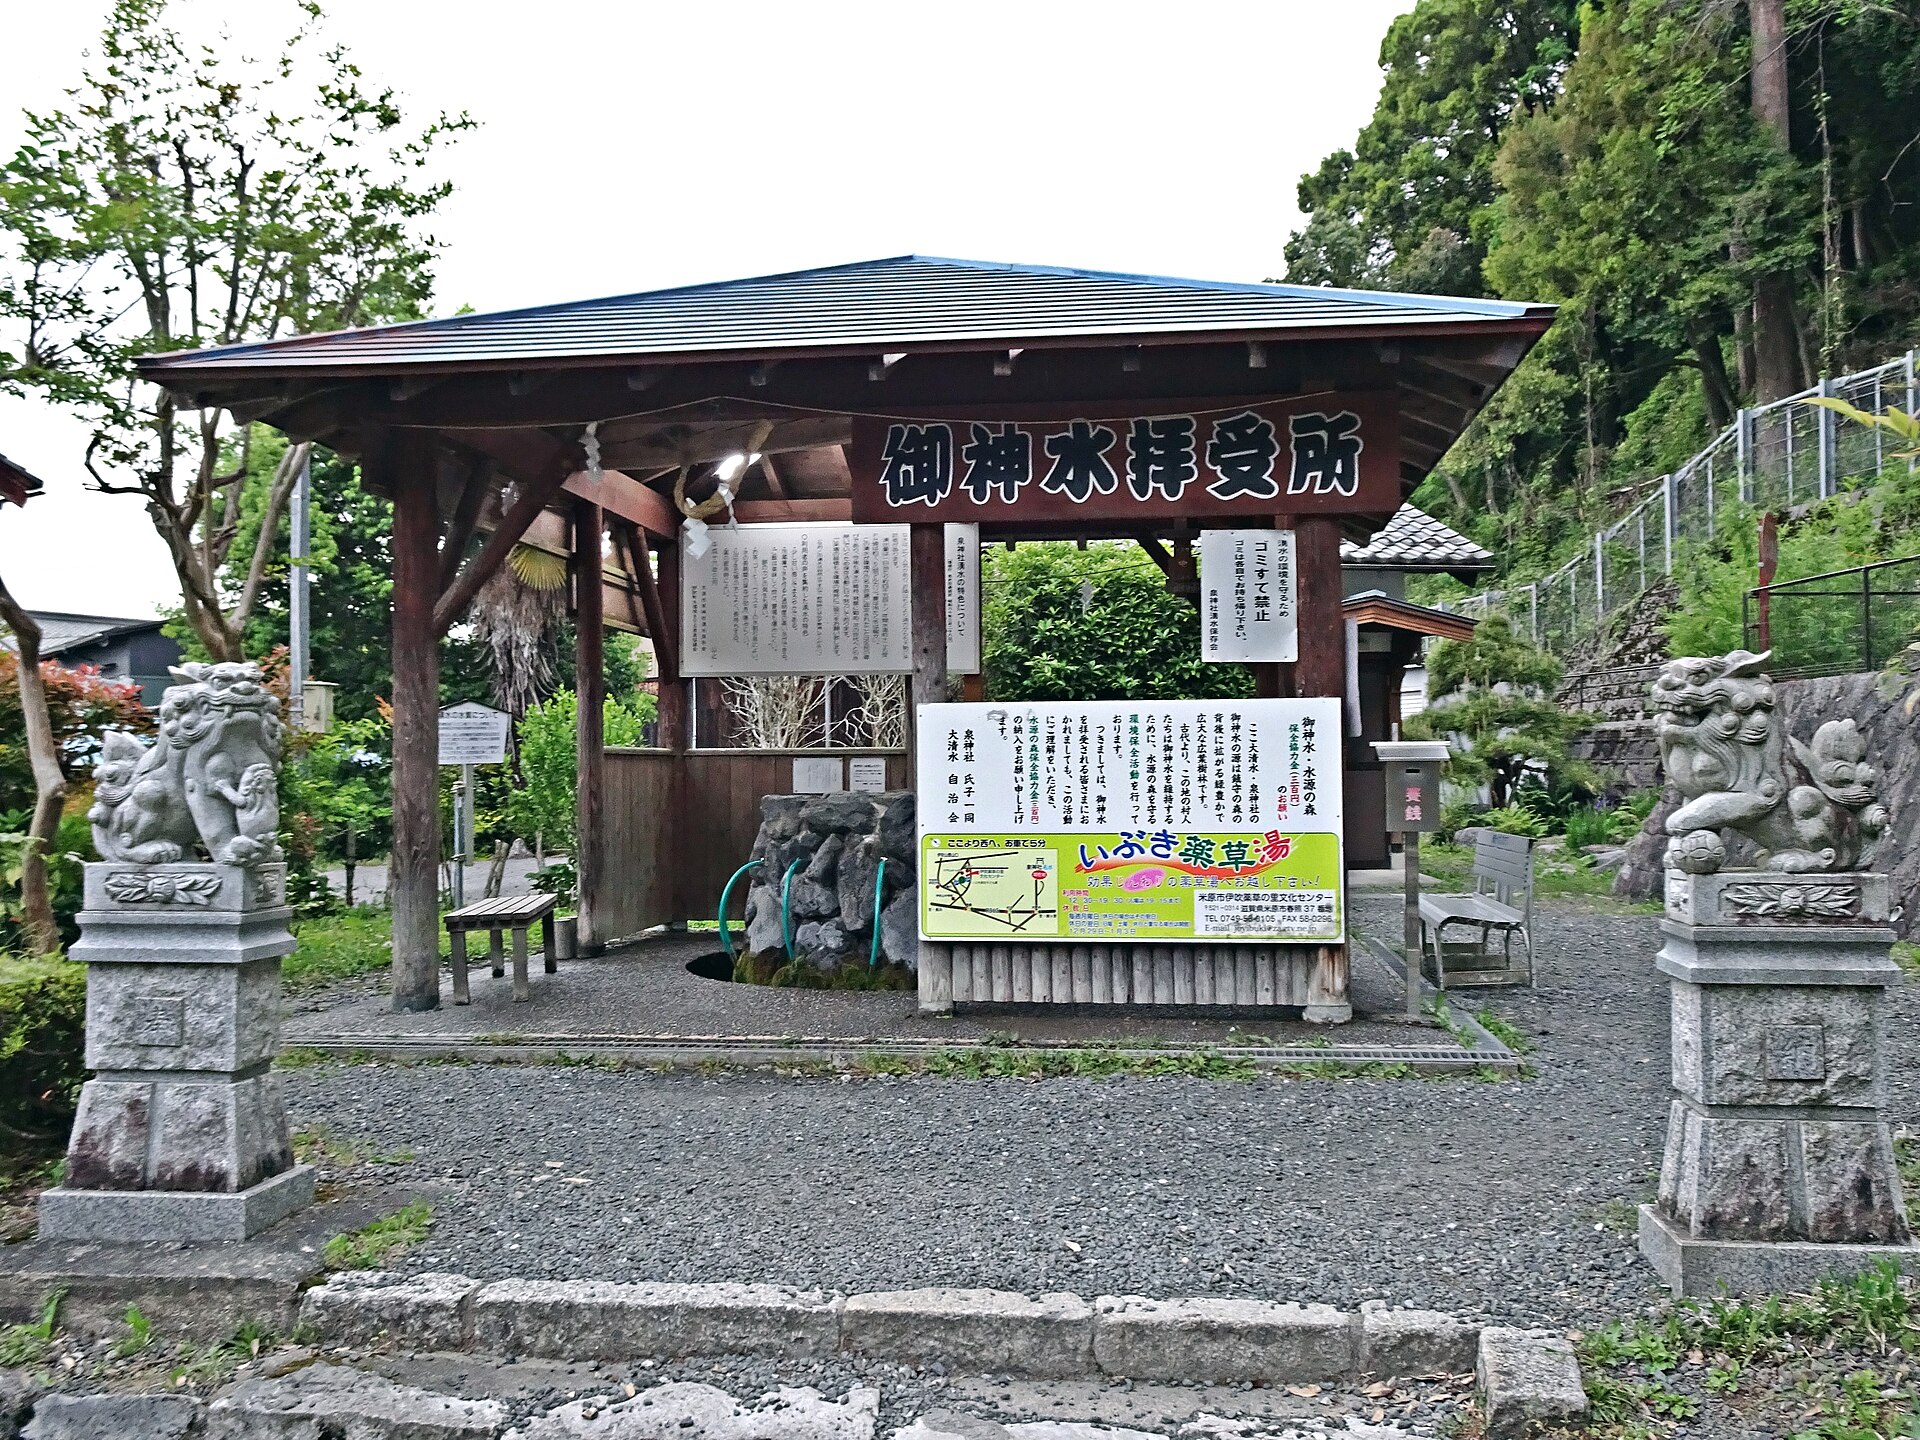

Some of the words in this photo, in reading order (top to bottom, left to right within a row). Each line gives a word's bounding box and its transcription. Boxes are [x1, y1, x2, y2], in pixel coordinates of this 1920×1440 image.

[878, 410, 1364, 507] 御神水拝受所
[1254, 540, 1271, 622] ゴミすて禁止
[1277, 539, 1289, 618] 湧水の環境を守るため
[1209, 589, 1218, 651] 泉神社湧水保存会
[1302, 716, 1318, 815] 御神水・水源の森
[964, 774, 976, 823] 氏子一同
[1079, 829, 1292, 872] いぶき薬草湯
[1198, 893, 1333, 902] 米原市伊吹薬草の里文化センター
[1303, 904, 1315, 913] 37
